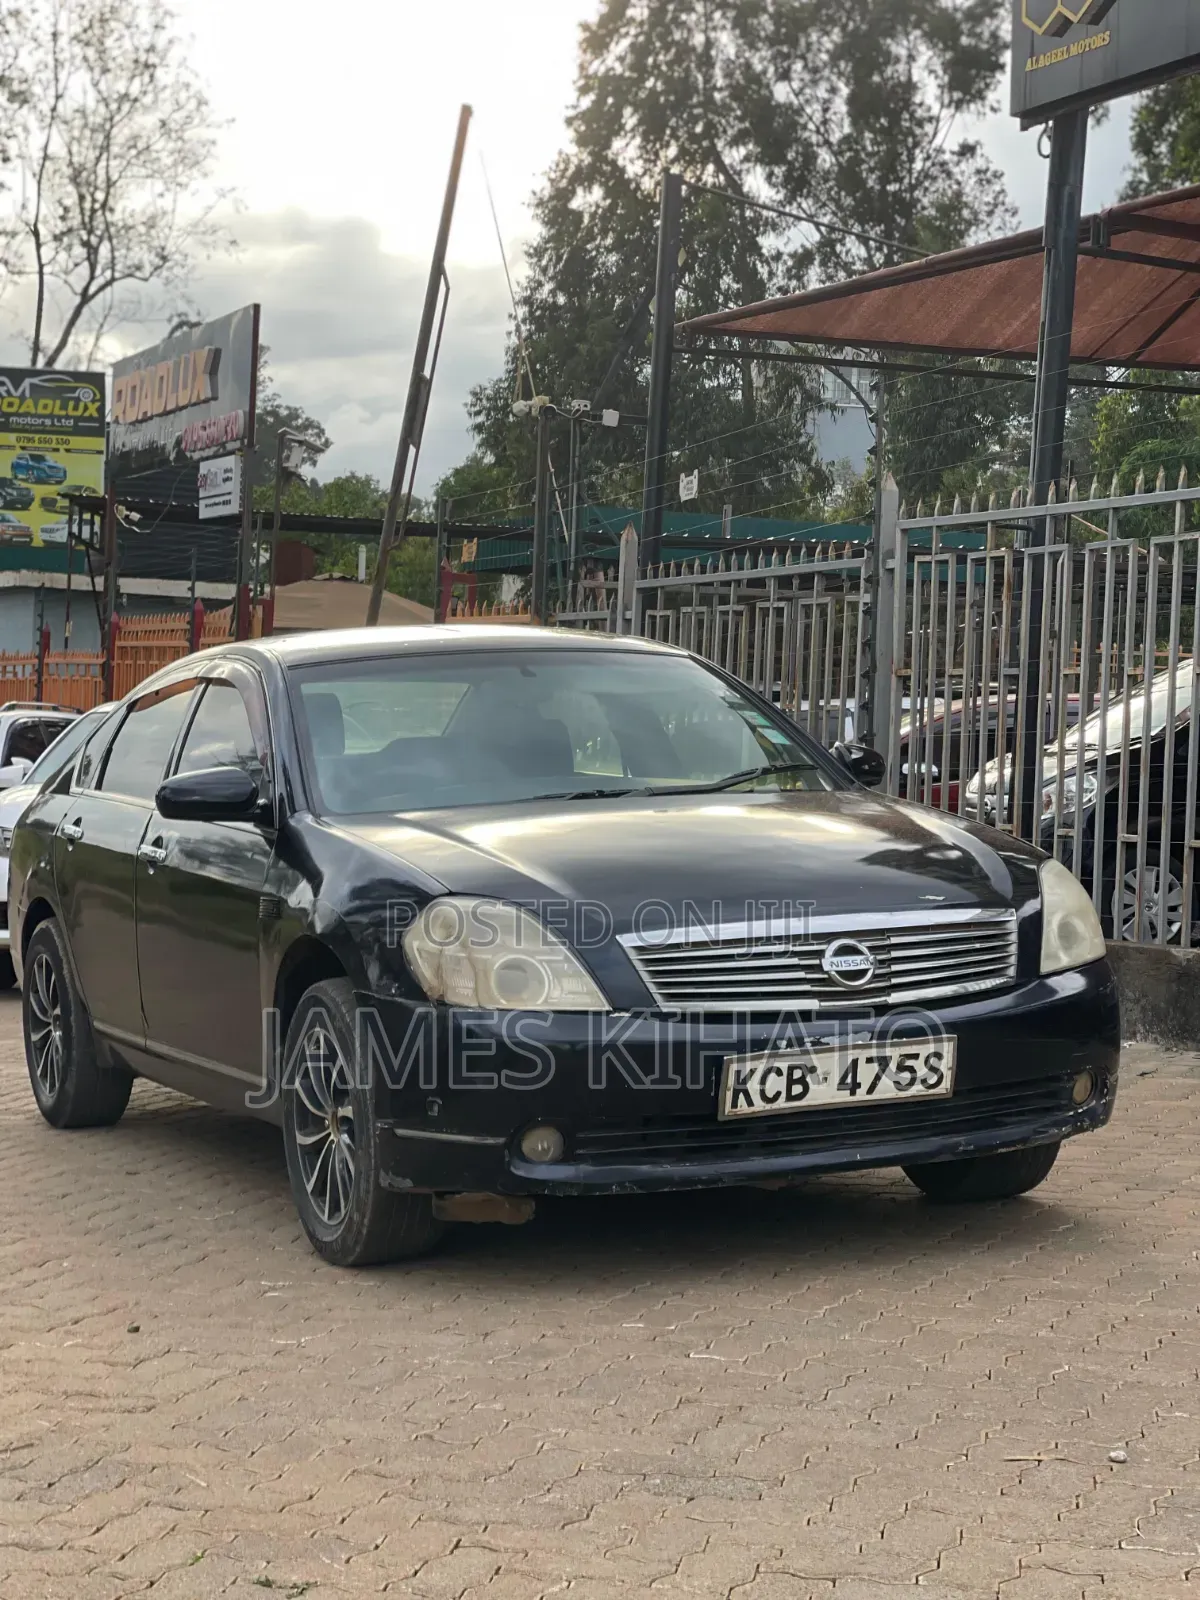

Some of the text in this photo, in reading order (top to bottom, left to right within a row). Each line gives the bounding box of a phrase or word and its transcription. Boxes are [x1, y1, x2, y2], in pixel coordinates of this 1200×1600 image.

[1025, 30, 1112, 72] ALAGEEL MOTORS
[112, 347, 214, 424] ROADLUX
[0, 397, 101, 417] OADLUX
[9, 416, 74, 426] motors Ltd
[830, 957, 874, 969] NISSAN
[730, 1050, 945, 1110] KCB 475S
